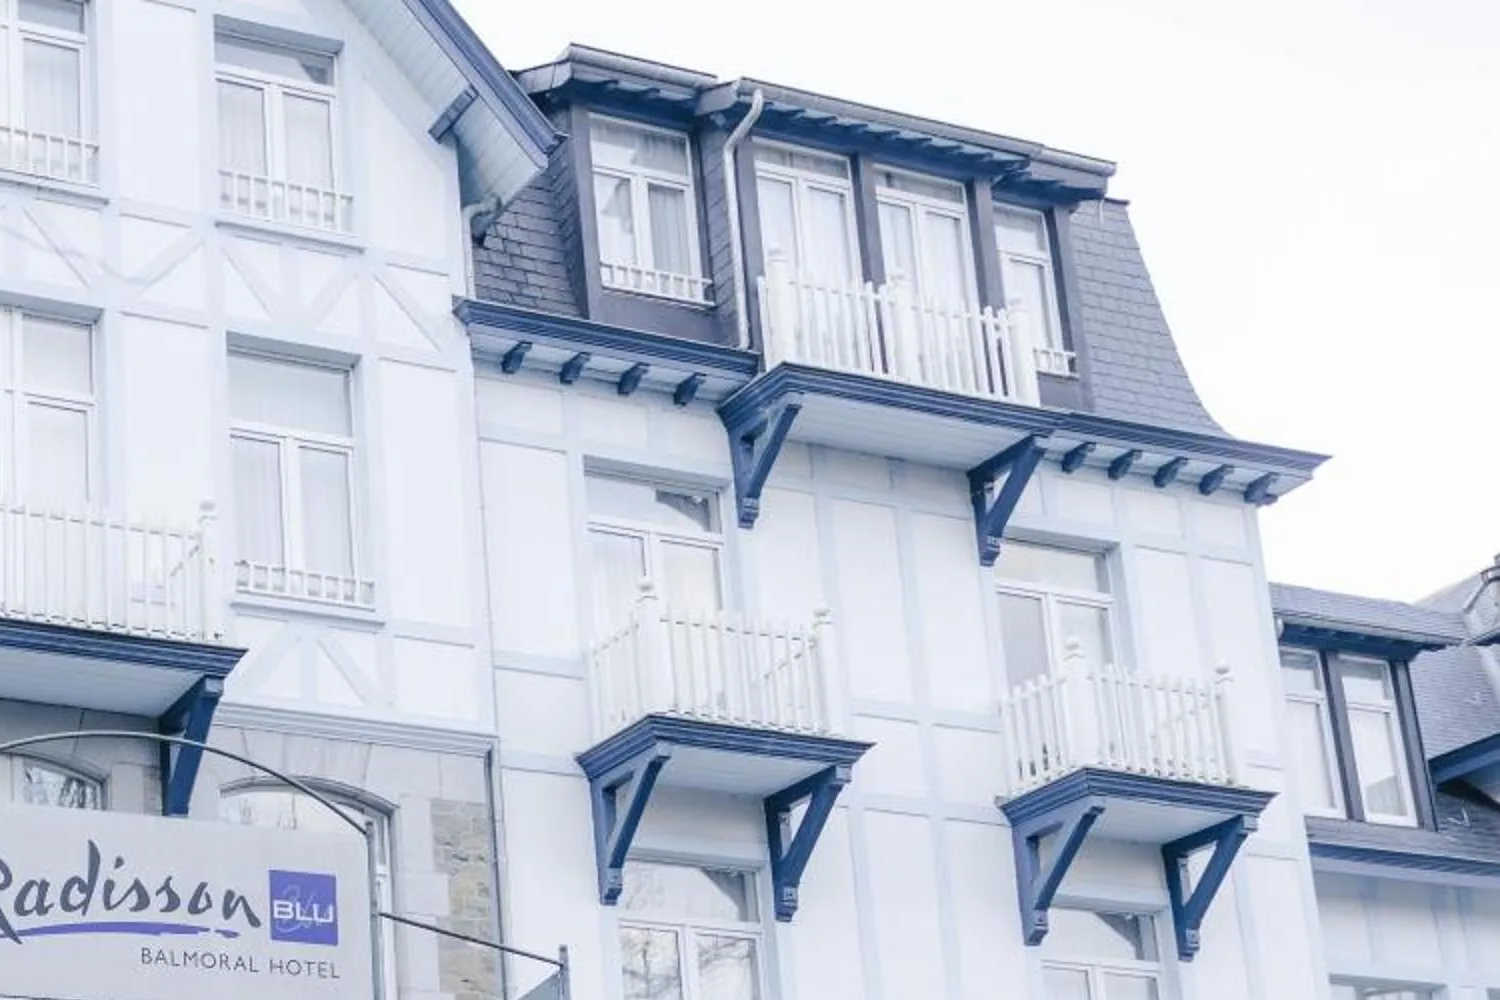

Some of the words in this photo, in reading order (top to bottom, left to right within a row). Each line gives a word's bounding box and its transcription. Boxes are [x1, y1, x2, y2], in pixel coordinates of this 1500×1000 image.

[273, 899, 334, 923] BLU
[140, 947, 259, 974] BALMORAL
[269, 957, 340, 979] HOTEL
